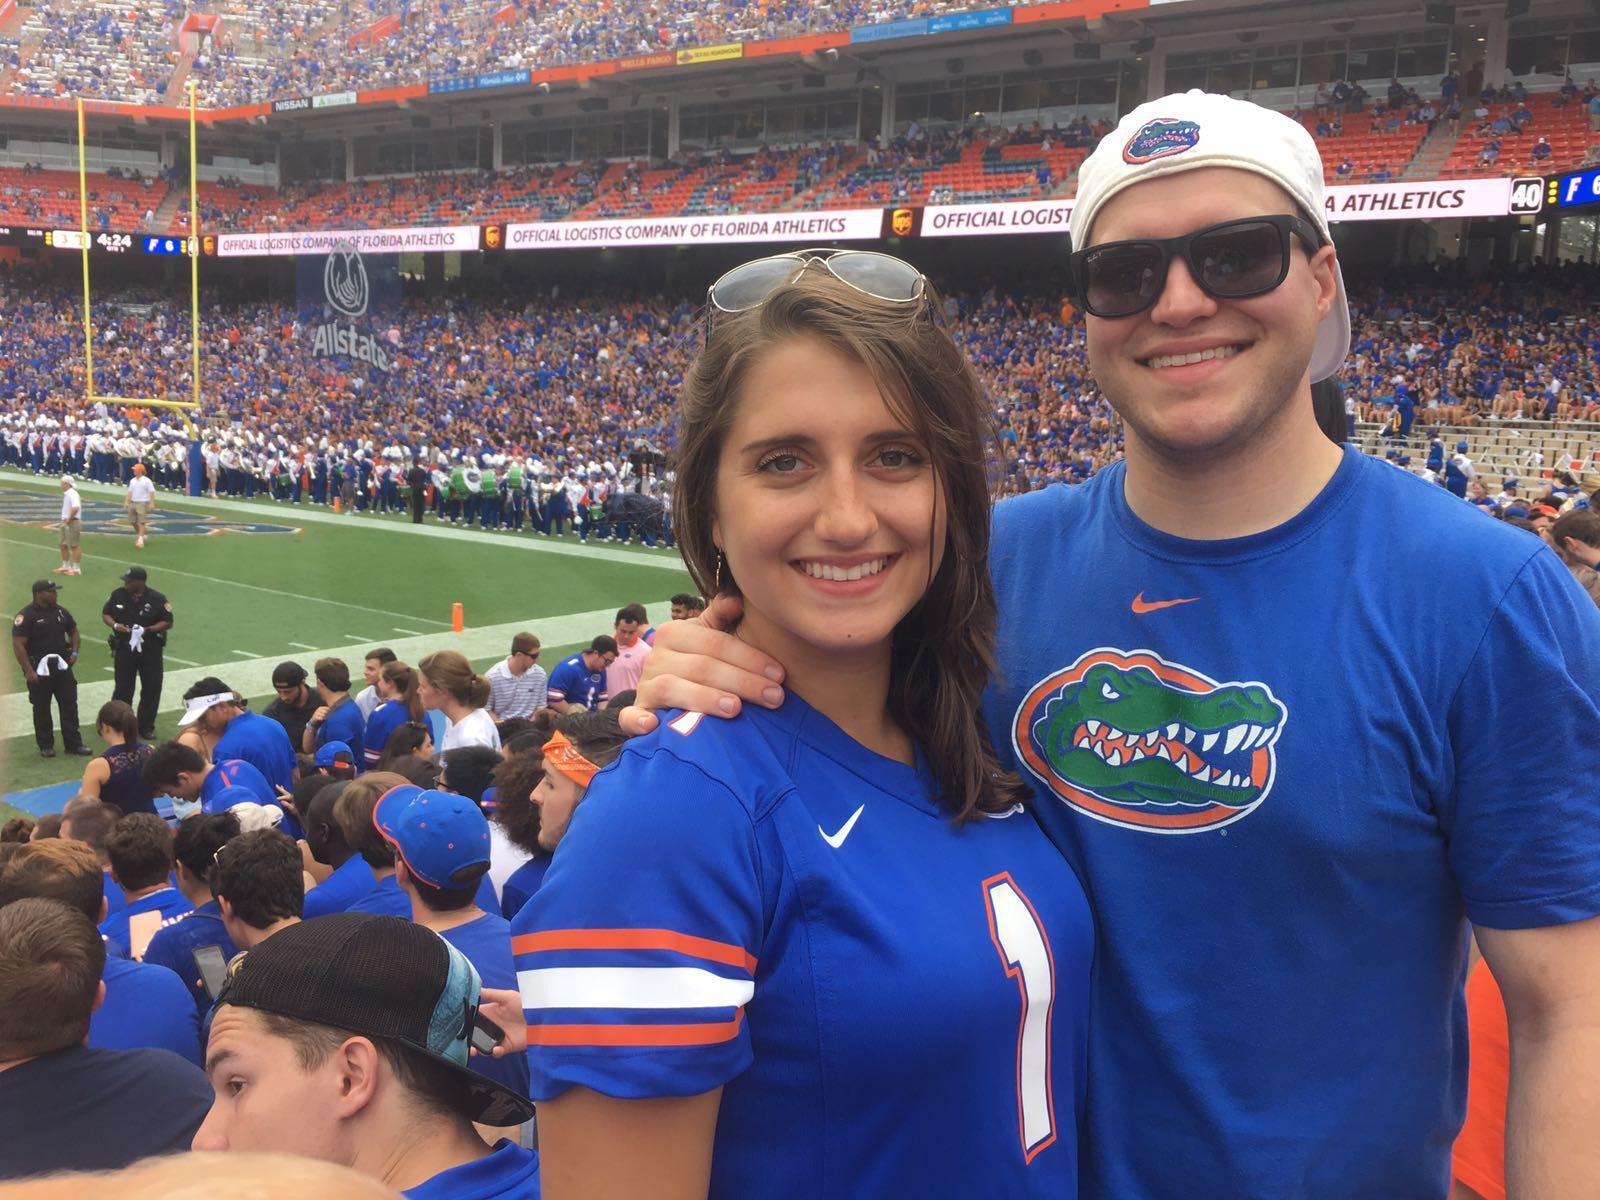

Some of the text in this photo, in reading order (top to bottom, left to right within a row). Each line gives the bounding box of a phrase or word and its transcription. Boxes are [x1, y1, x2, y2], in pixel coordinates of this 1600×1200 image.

[275, 98, 309, 112] NISSAN
[1341, 189, 1466, 212] ATHLETICS
[1511, 183, 1540, 208] 40
[1565, 176, 1582, 202] F
[513, 229, 561, 243] OFFICIAL
[565, 226, 622, 241] LOGISTICS
[625, 223, 688, 240] COMPANY
[690, 223, 710, 237] OF
[712, 221, 768, 236] FLORIDA
[772, 218, 846, 235] ATHLETICS
[933, 211, 1006, 229] OFFICIAL
[97, 233, 132, 248] 4:24
[223, 239, 257, 251] OFFICIAL
[259, 237, 301, 250] LOGISTICS
[363, 234, 403, 247] FLORIDA
[405, 232, 455, 246] ATHLETICS
[312, 319, 389, 372] Allstate
[982, 871, 1057, 1165] 1
